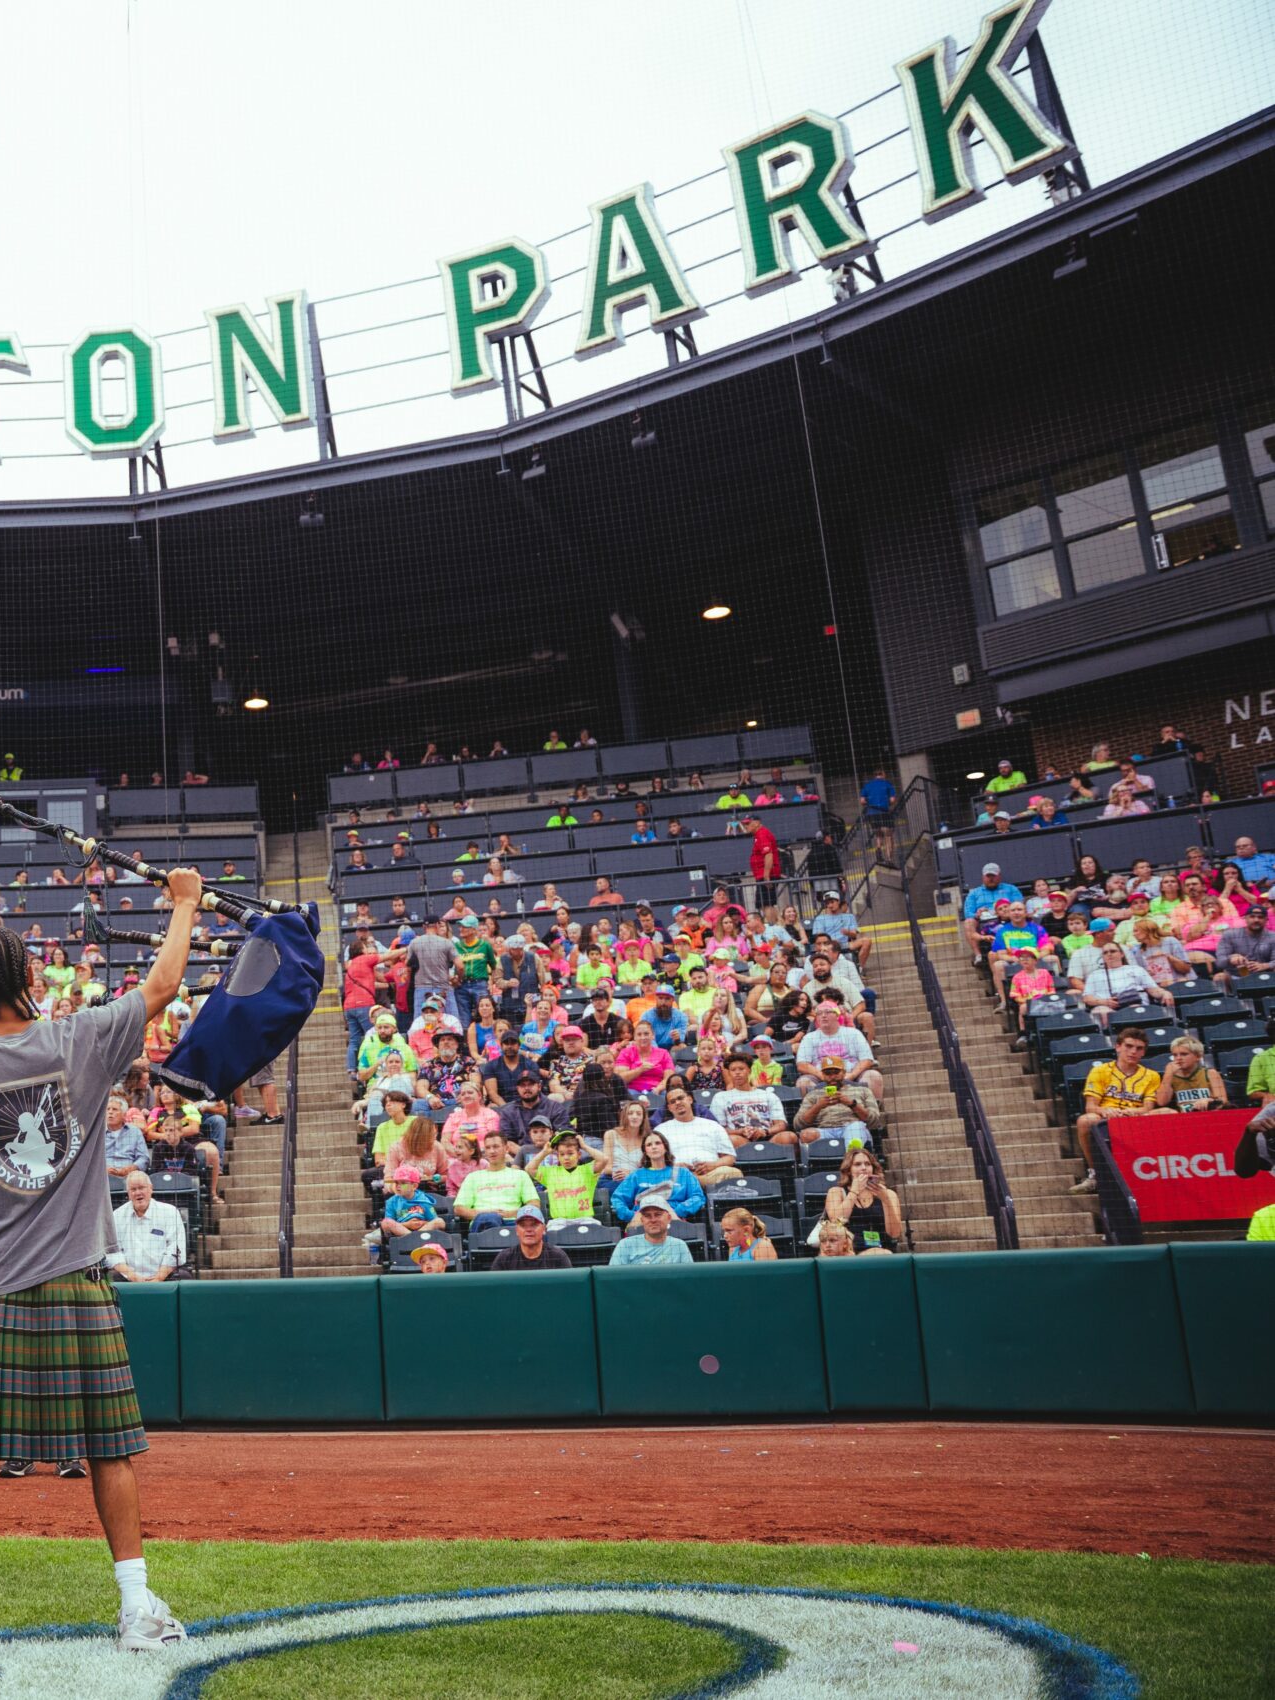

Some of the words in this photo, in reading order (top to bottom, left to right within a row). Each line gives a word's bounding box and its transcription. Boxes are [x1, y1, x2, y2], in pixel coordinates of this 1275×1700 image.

[436, 0, 1077, 399] PARK
[1178, 1089, 1210, 1101] RISH
[18, 1176, 46, 1189] THE
[49, 1117, 82, 1183] BPIPER
[1133, 1152, 1237, 1181] CIRCL
